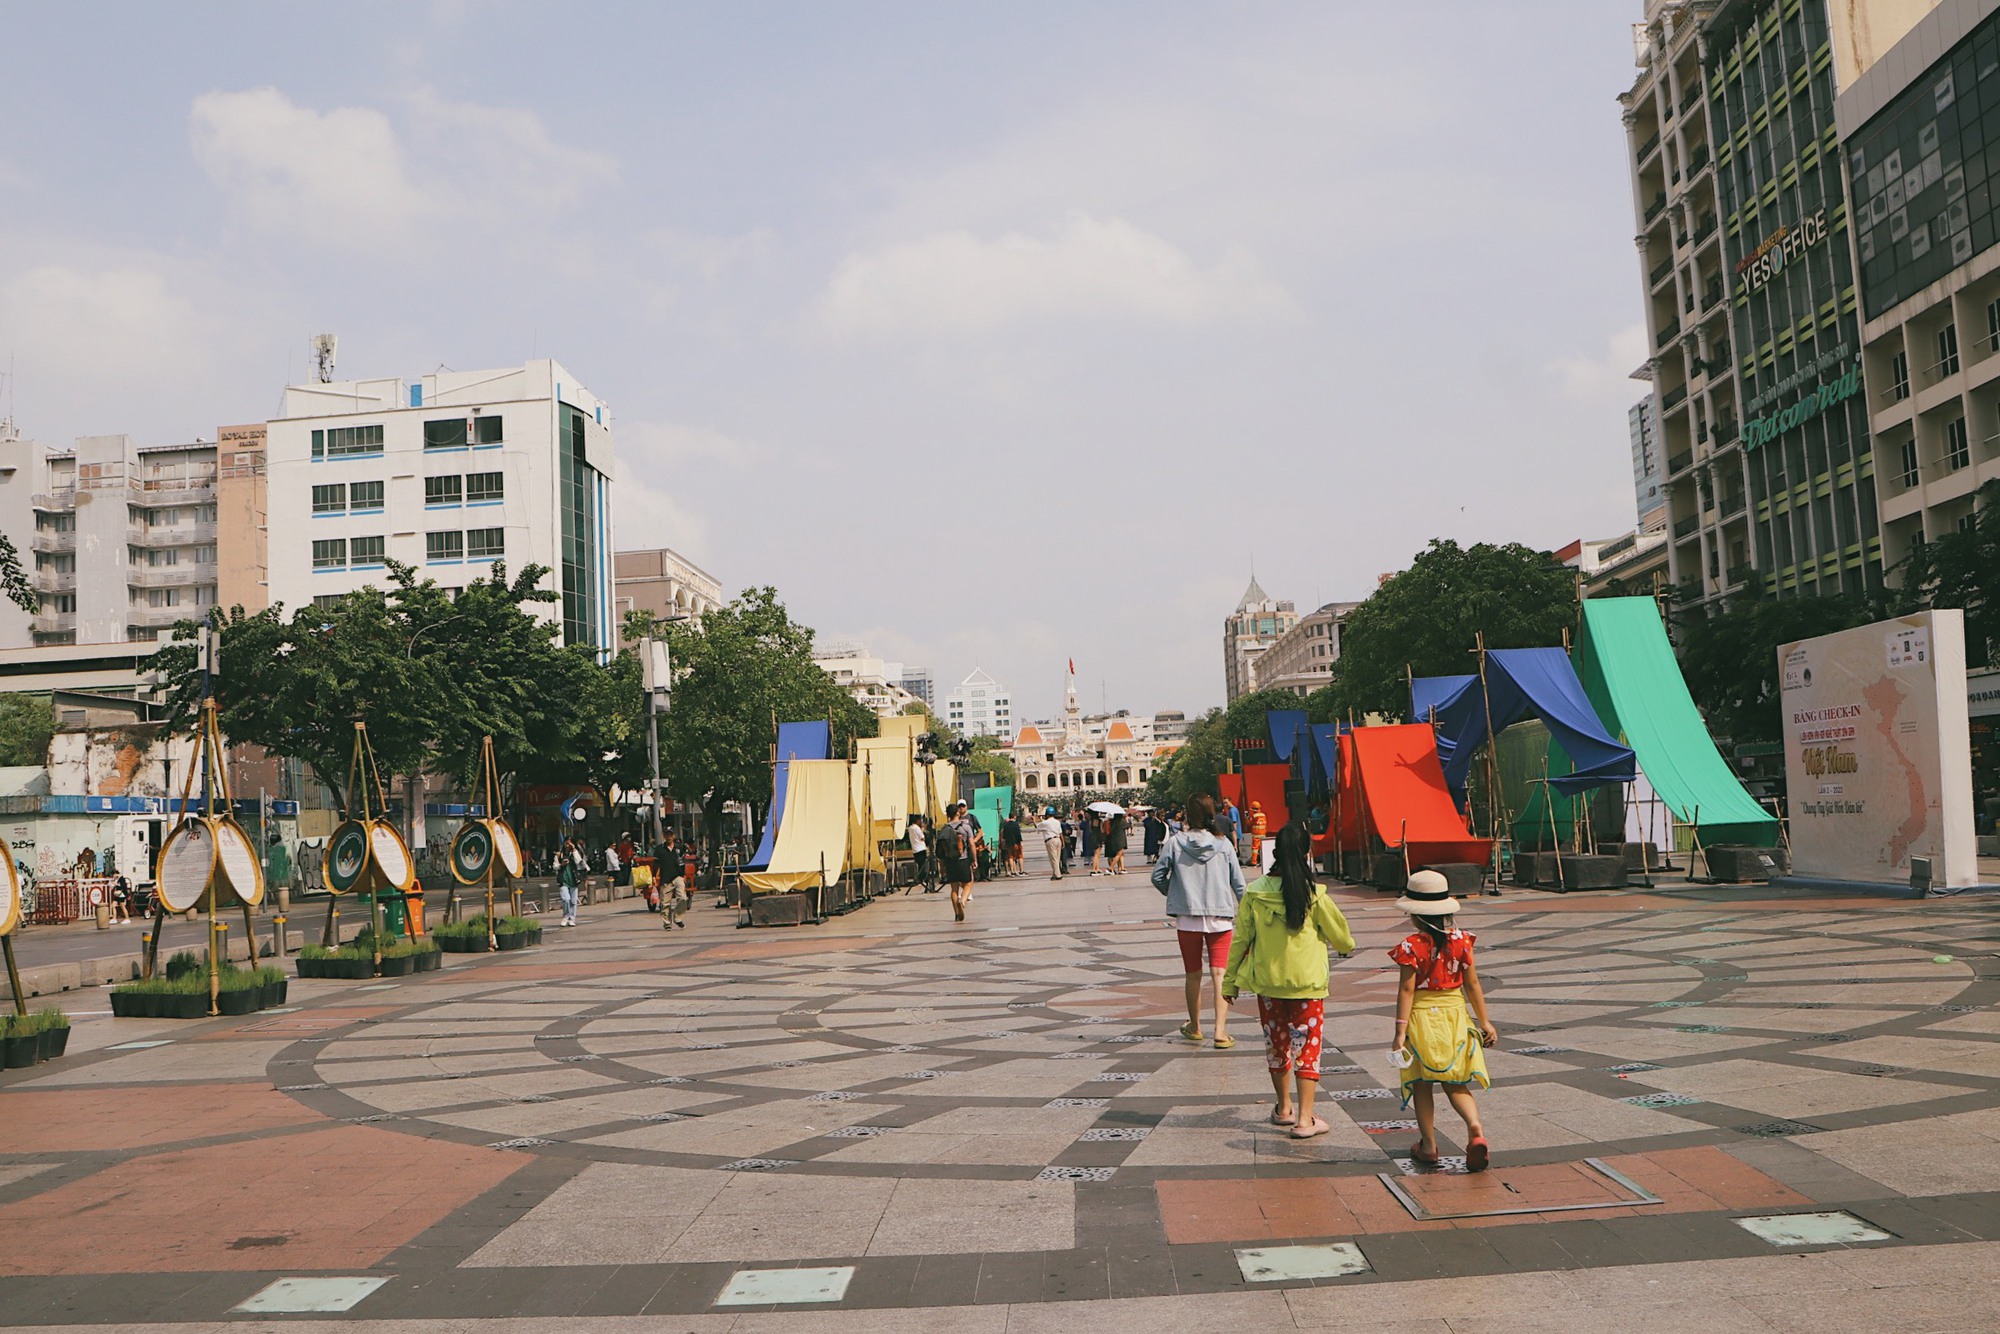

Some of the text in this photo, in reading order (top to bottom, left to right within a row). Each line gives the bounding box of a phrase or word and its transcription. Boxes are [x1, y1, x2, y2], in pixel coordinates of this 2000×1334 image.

[222, 430, 267, 441] ROYAL HOT
[1794, 704, 1861, 724] BẢNG CHECK-IN
